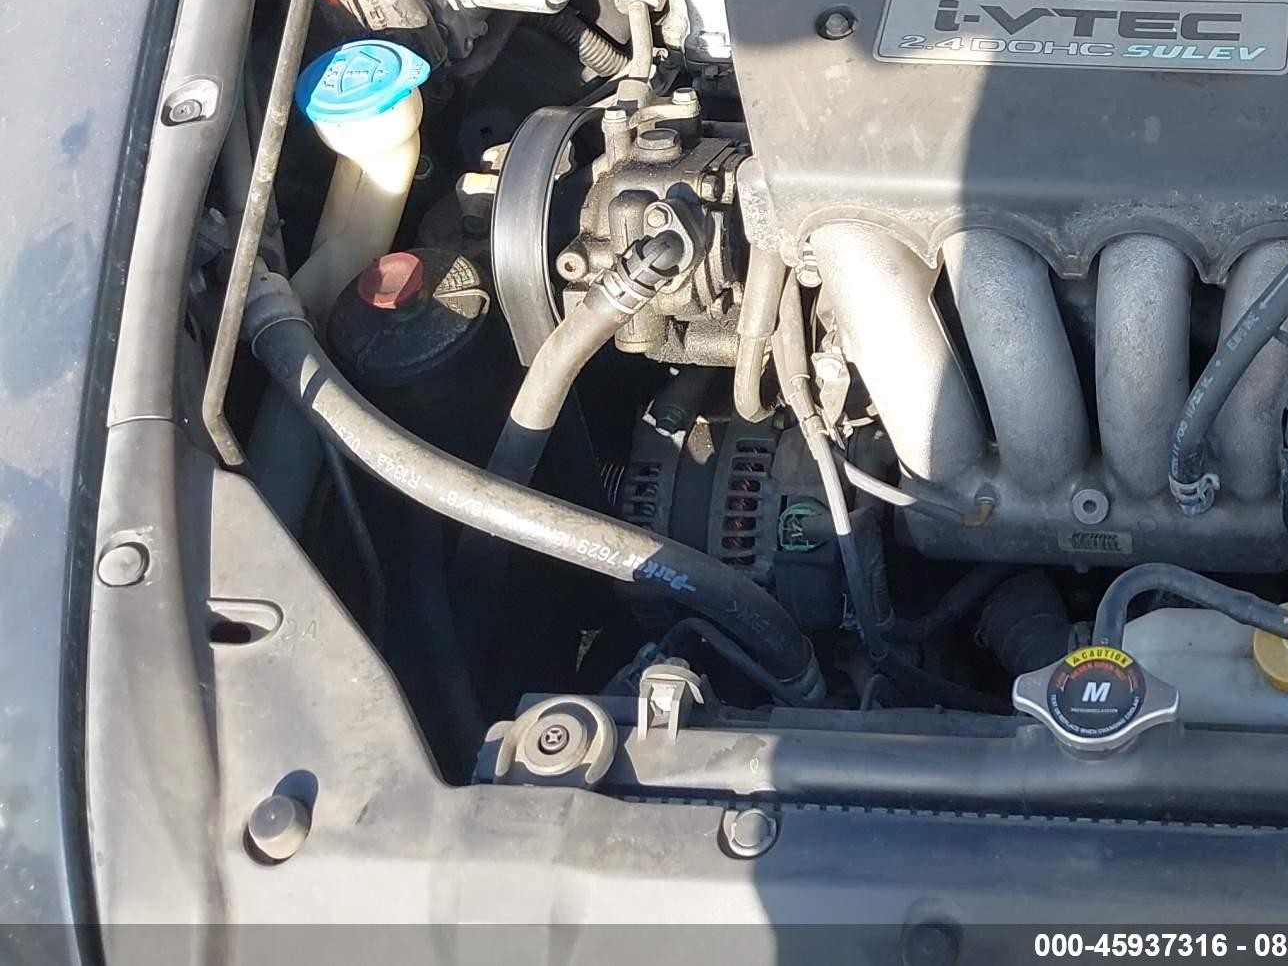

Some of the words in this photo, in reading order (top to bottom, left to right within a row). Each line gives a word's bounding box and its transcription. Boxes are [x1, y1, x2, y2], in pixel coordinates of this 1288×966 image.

[969, 36, 1116, 58] DOHC
[1122, 43, 1267, 62] SULEV
[377, 453, 422, 490] R134a
[577, 538, 621, 566] 7629
[623, 554, 696, 592] Parker
[1081, 649, 1128, 664] CAUTION
[1081, 681, 1112, 703] M
